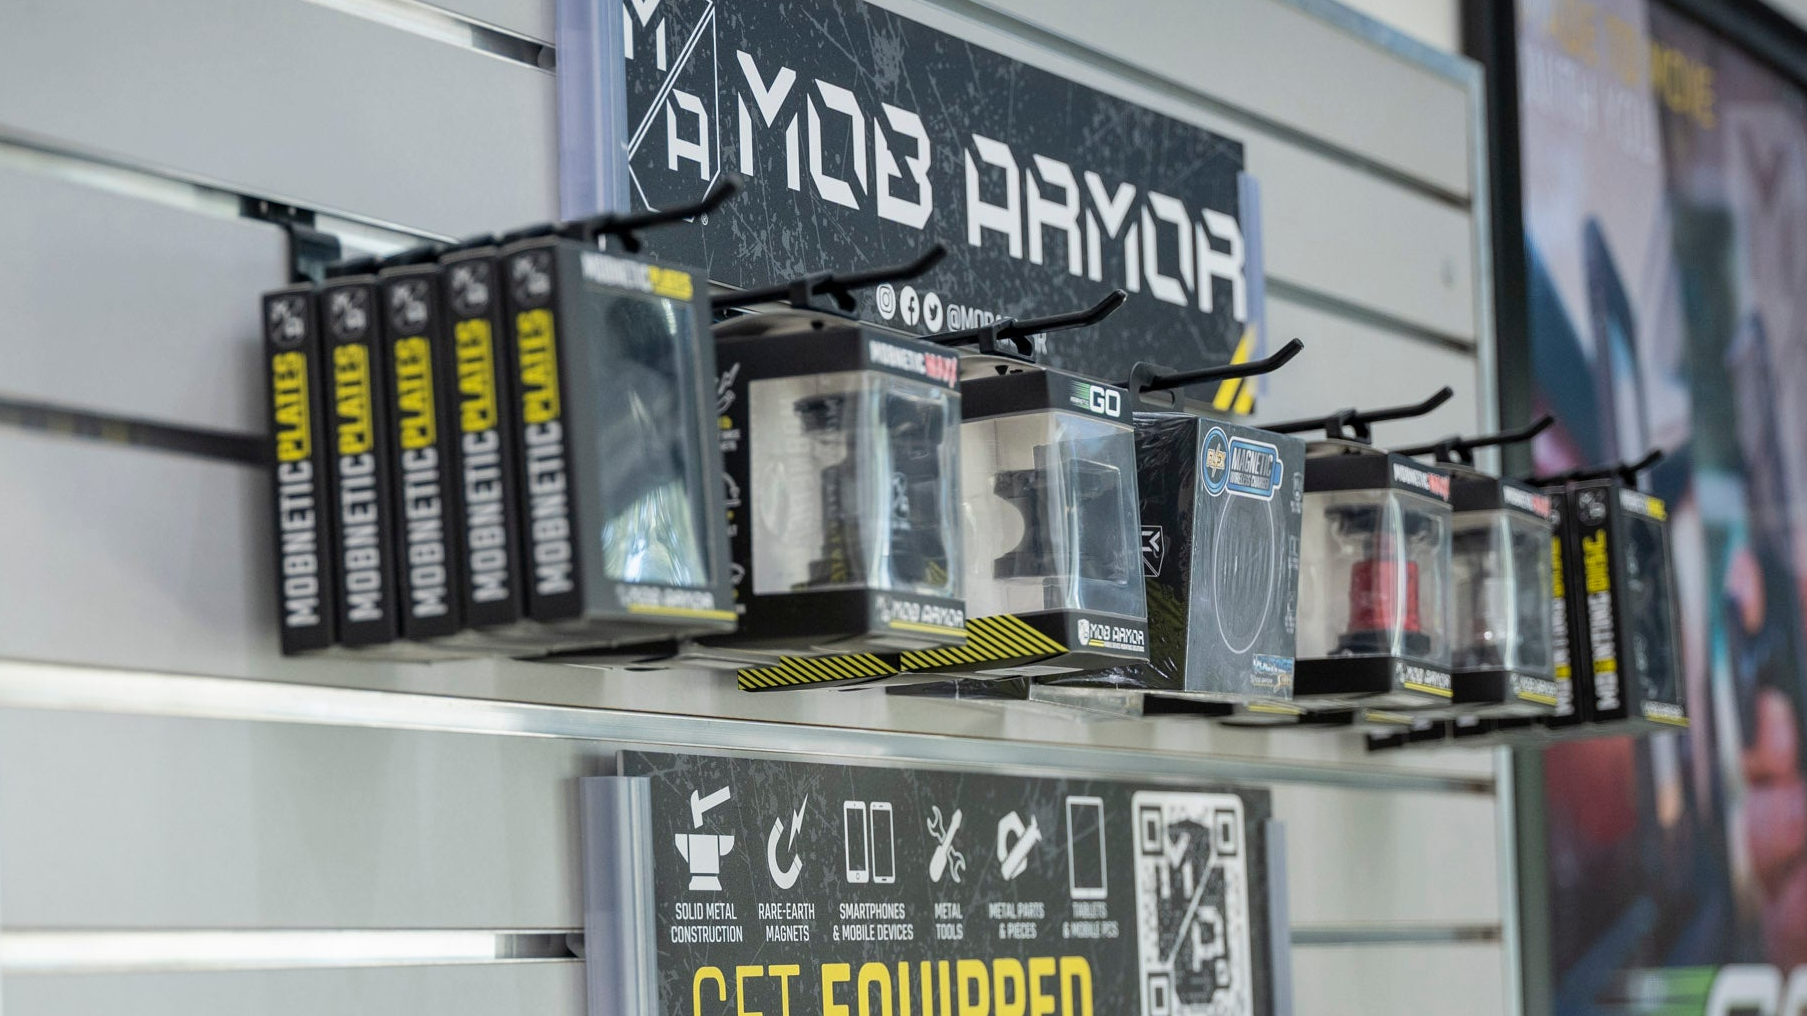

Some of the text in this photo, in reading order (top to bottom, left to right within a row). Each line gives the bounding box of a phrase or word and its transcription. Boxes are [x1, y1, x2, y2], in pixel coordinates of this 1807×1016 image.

[737, 50, 1246, 322] MOB ARMOR
[1089, 385, 1120, 418] GO
[1231, 446, 1274, 477] MAGNETIC
[892, 600, 964, 629] MOB ARMOR
[1090, 623, 1145, 646] MOB ARMOR
[675, 902, 737, 920] SOLID METAL
[758, 902, 815, 920] RARE-EARTH
[839, 902, 905, 920] SMARTPHONES
[934, 902, 963, 919] METAL
[988, 902, 1045, 919] METAL PARTS
[670, 925, 743, 943] CONSTRUCTION
[766, 925, 810, 942] MAGNETS
[832, 924, 914, 941] & MOBILE DEVICES
[935, 923, 964, 940] TOOLS
[1007, 922, 1038, 940] PIECES
